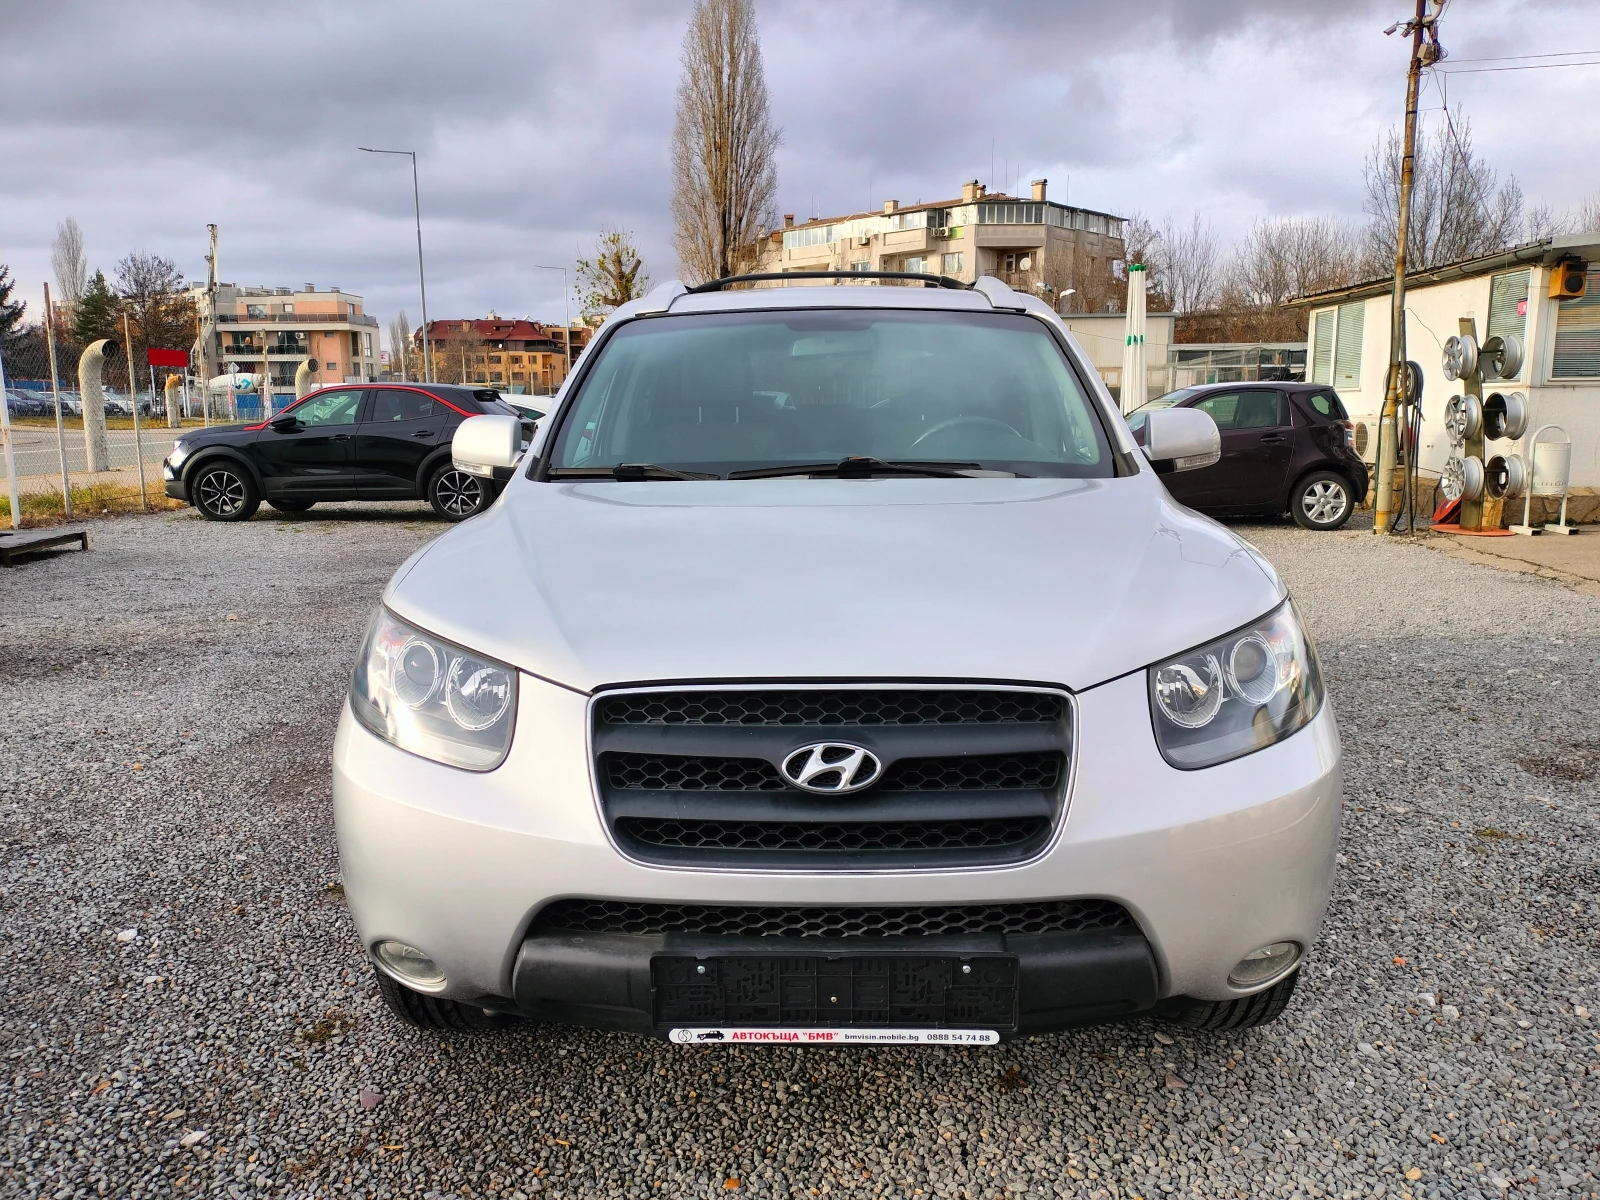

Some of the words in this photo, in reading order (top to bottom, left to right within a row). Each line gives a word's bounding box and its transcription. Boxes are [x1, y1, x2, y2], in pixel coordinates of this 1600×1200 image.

[732, 1032, 800, 1041] АВТОКЪЩА
[844, 1033, 919, 1042] bmvisin.mobile.bg
[965, 1034, 976, 1042] 74
[979, 1034, 990, 1042] 88
